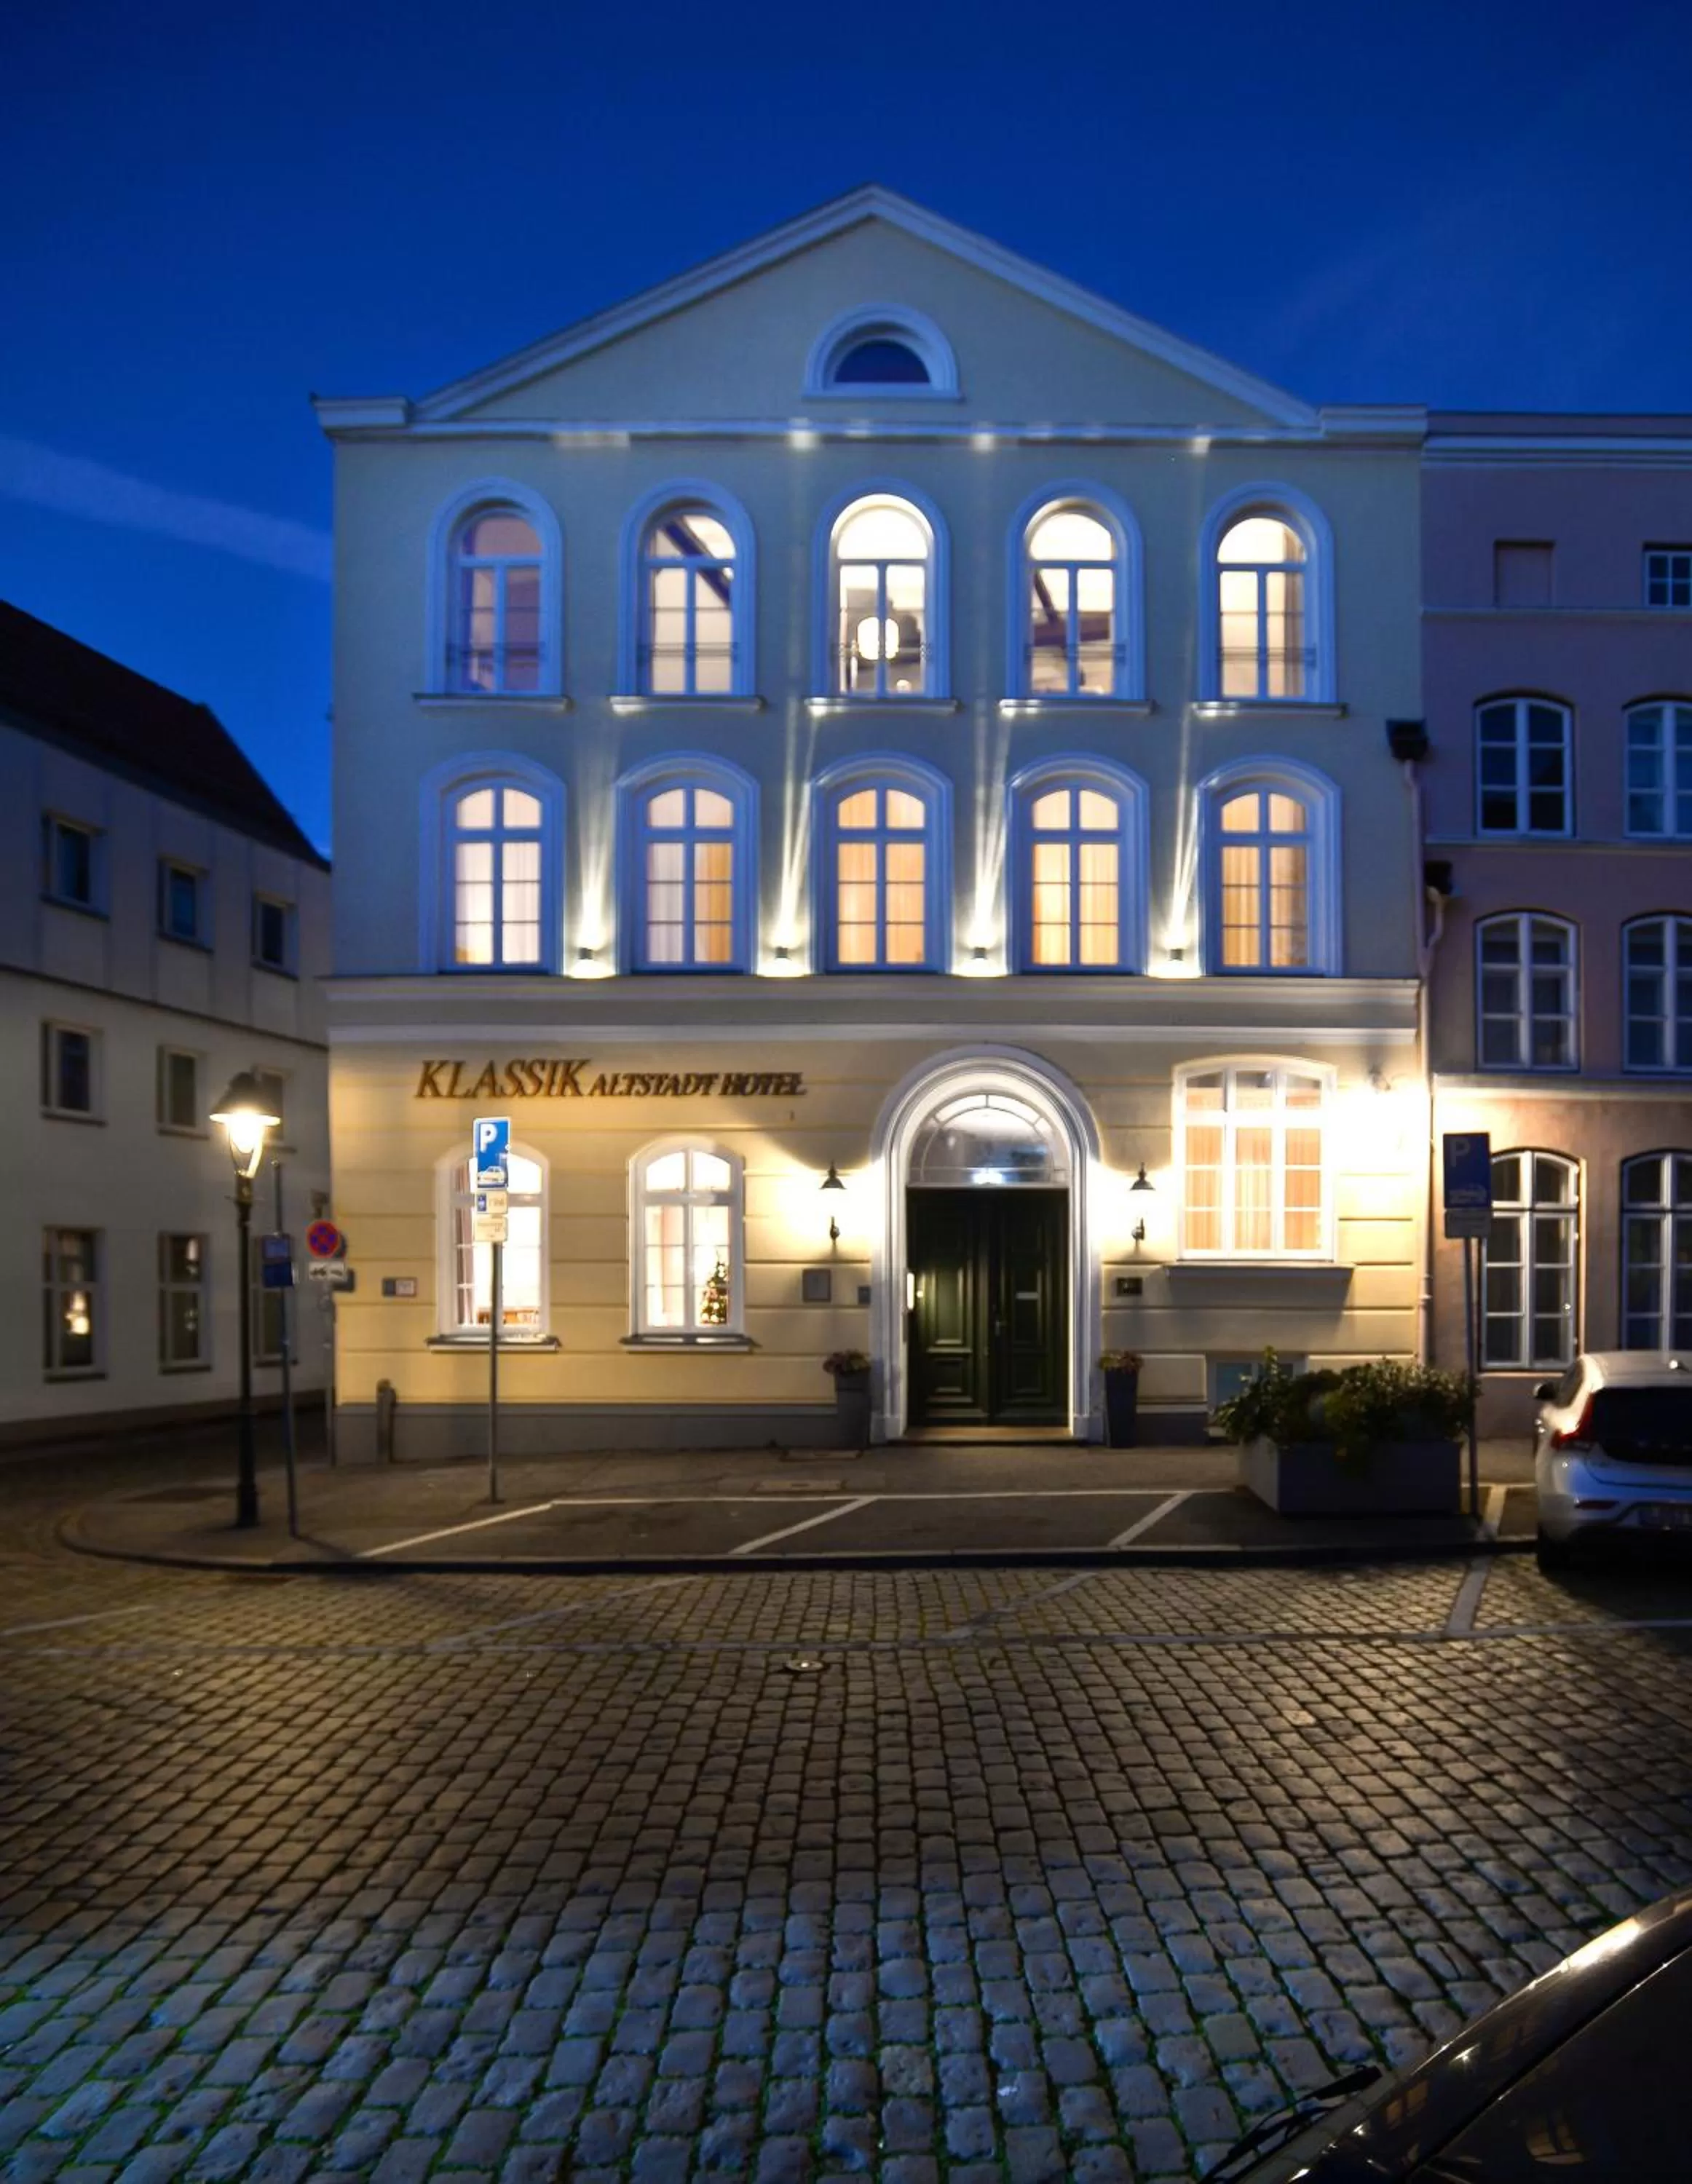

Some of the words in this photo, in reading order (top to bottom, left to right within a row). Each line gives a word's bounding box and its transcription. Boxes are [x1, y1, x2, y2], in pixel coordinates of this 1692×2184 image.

[415, 1059, 591, 1099] KLASSIK
[588, 1072, 719, 1096] ALTSTADT
[718, 1071, 807, 1096] HOTEL
[480, 1123, 497, 1152] P
[1450, 1138, 1471, 1168] P
